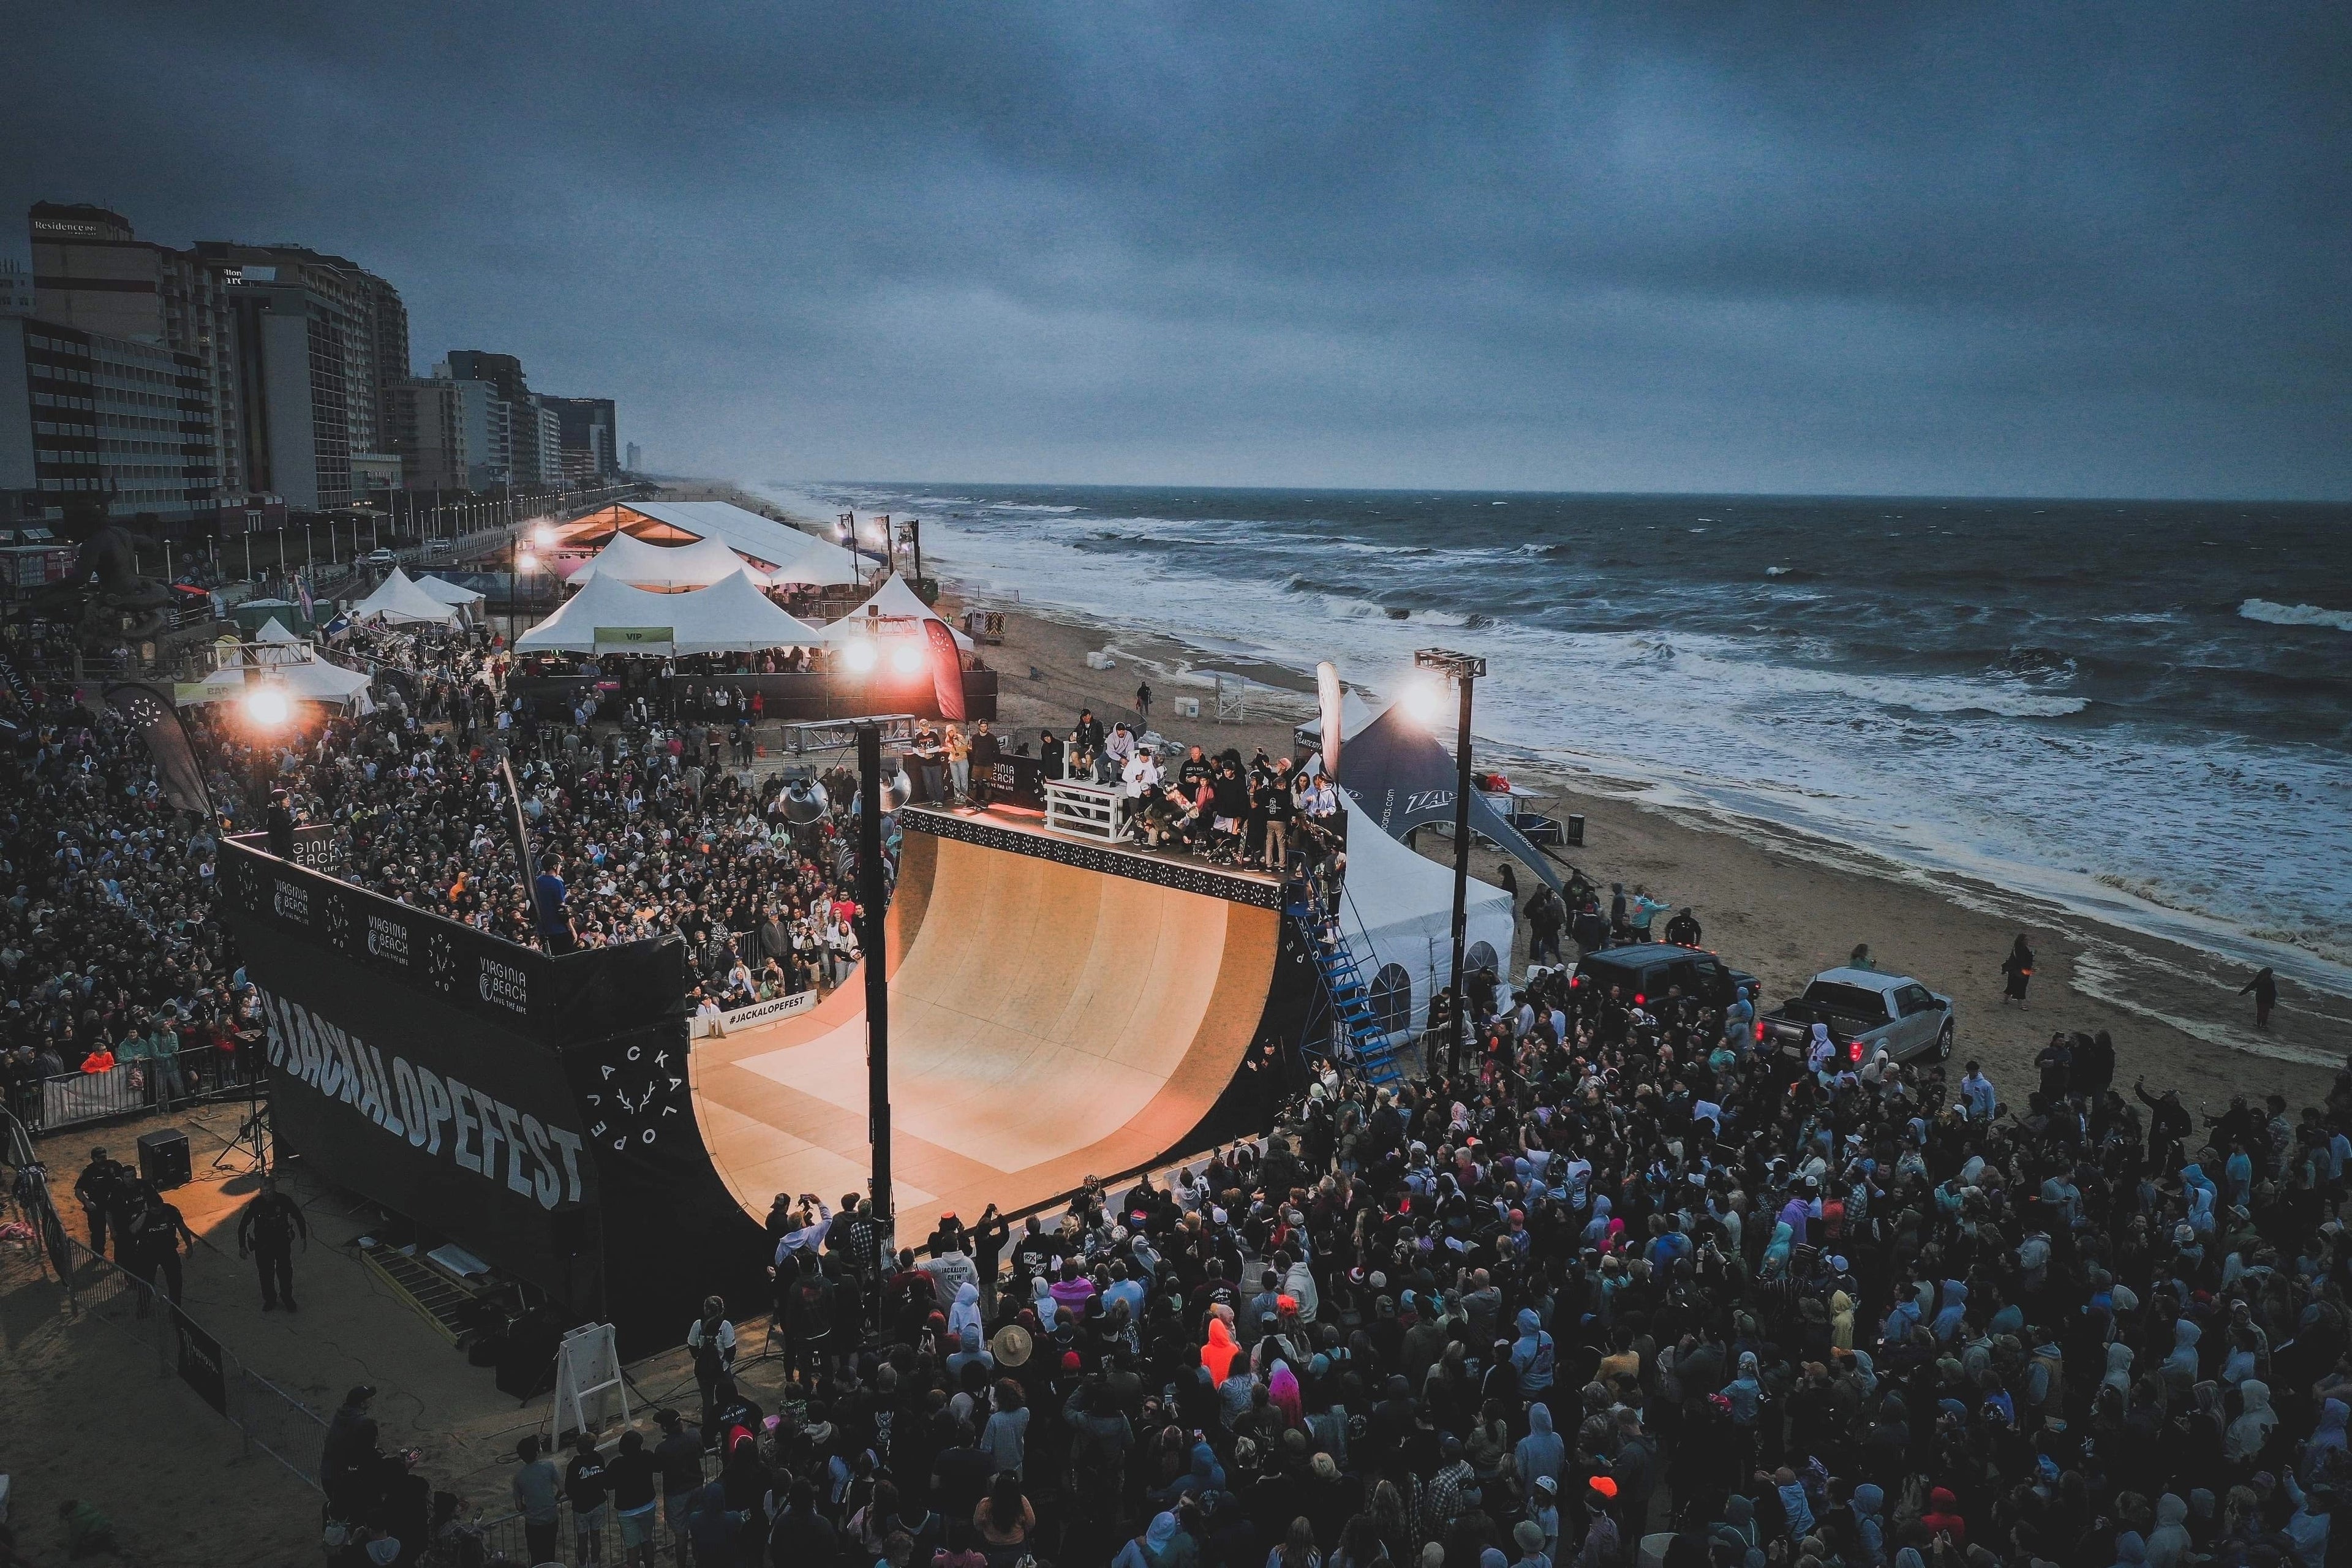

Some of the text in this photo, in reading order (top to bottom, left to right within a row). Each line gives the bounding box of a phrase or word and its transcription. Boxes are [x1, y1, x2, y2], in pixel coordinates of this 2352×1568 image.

[36, 221, 84, 231] Residence
[993, 772, 1014, 784] EACH
[1405, 790, 1458, 815] ZAP
[296, 852, 336, 866] EACH
[274, 878, 308, 902] VIRGINIA
[284, 895, 308, 916] BEACH
[368, 914, 407, 941] VIRGINIA
[380, 933, 409, 955] BEACH
[480, 956, 526, 987] VIRGINIA
[493, 978, 527, 1003] BEACH
[493, 996, 527, 1015] LIVE THE LIFE
[729, 997, 805, 1025] #JACKALOPEFEST
[257, 986, 583, 1211] #JACKALOPEFEST
[587, 1046, 682, 1150] JACKALOPE
